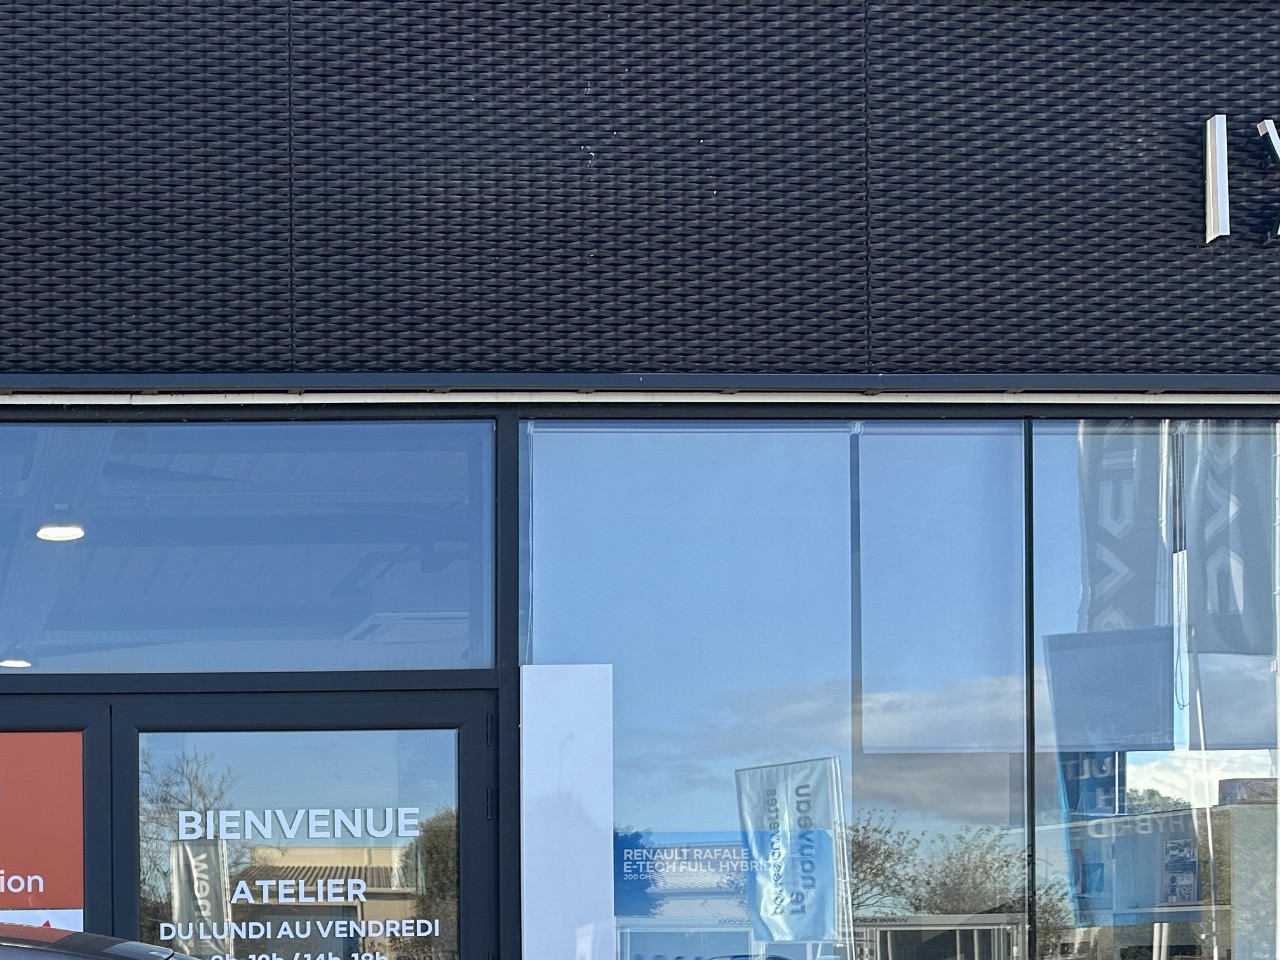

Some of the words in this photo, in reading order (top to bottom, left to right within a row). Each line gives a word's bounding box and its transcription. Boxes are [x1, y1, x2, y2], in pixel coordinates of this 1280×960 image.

[178, 807, 420, 840] BIENVENUE
[623, 848, 689, 860] RENAULT
[693, 848, 750, 860] RAFALE
[623, 861, 677, 873] E-TECH
[679, 861, 716, 872] FULL
[231, 878, 368, 905] ATELIER
[159, 922, 194, 941] DU
[198, 921, 272, 940] LUNDI
[276, 920, 311, 939] AU
[316, 919, 440, 938] VENDREDI
